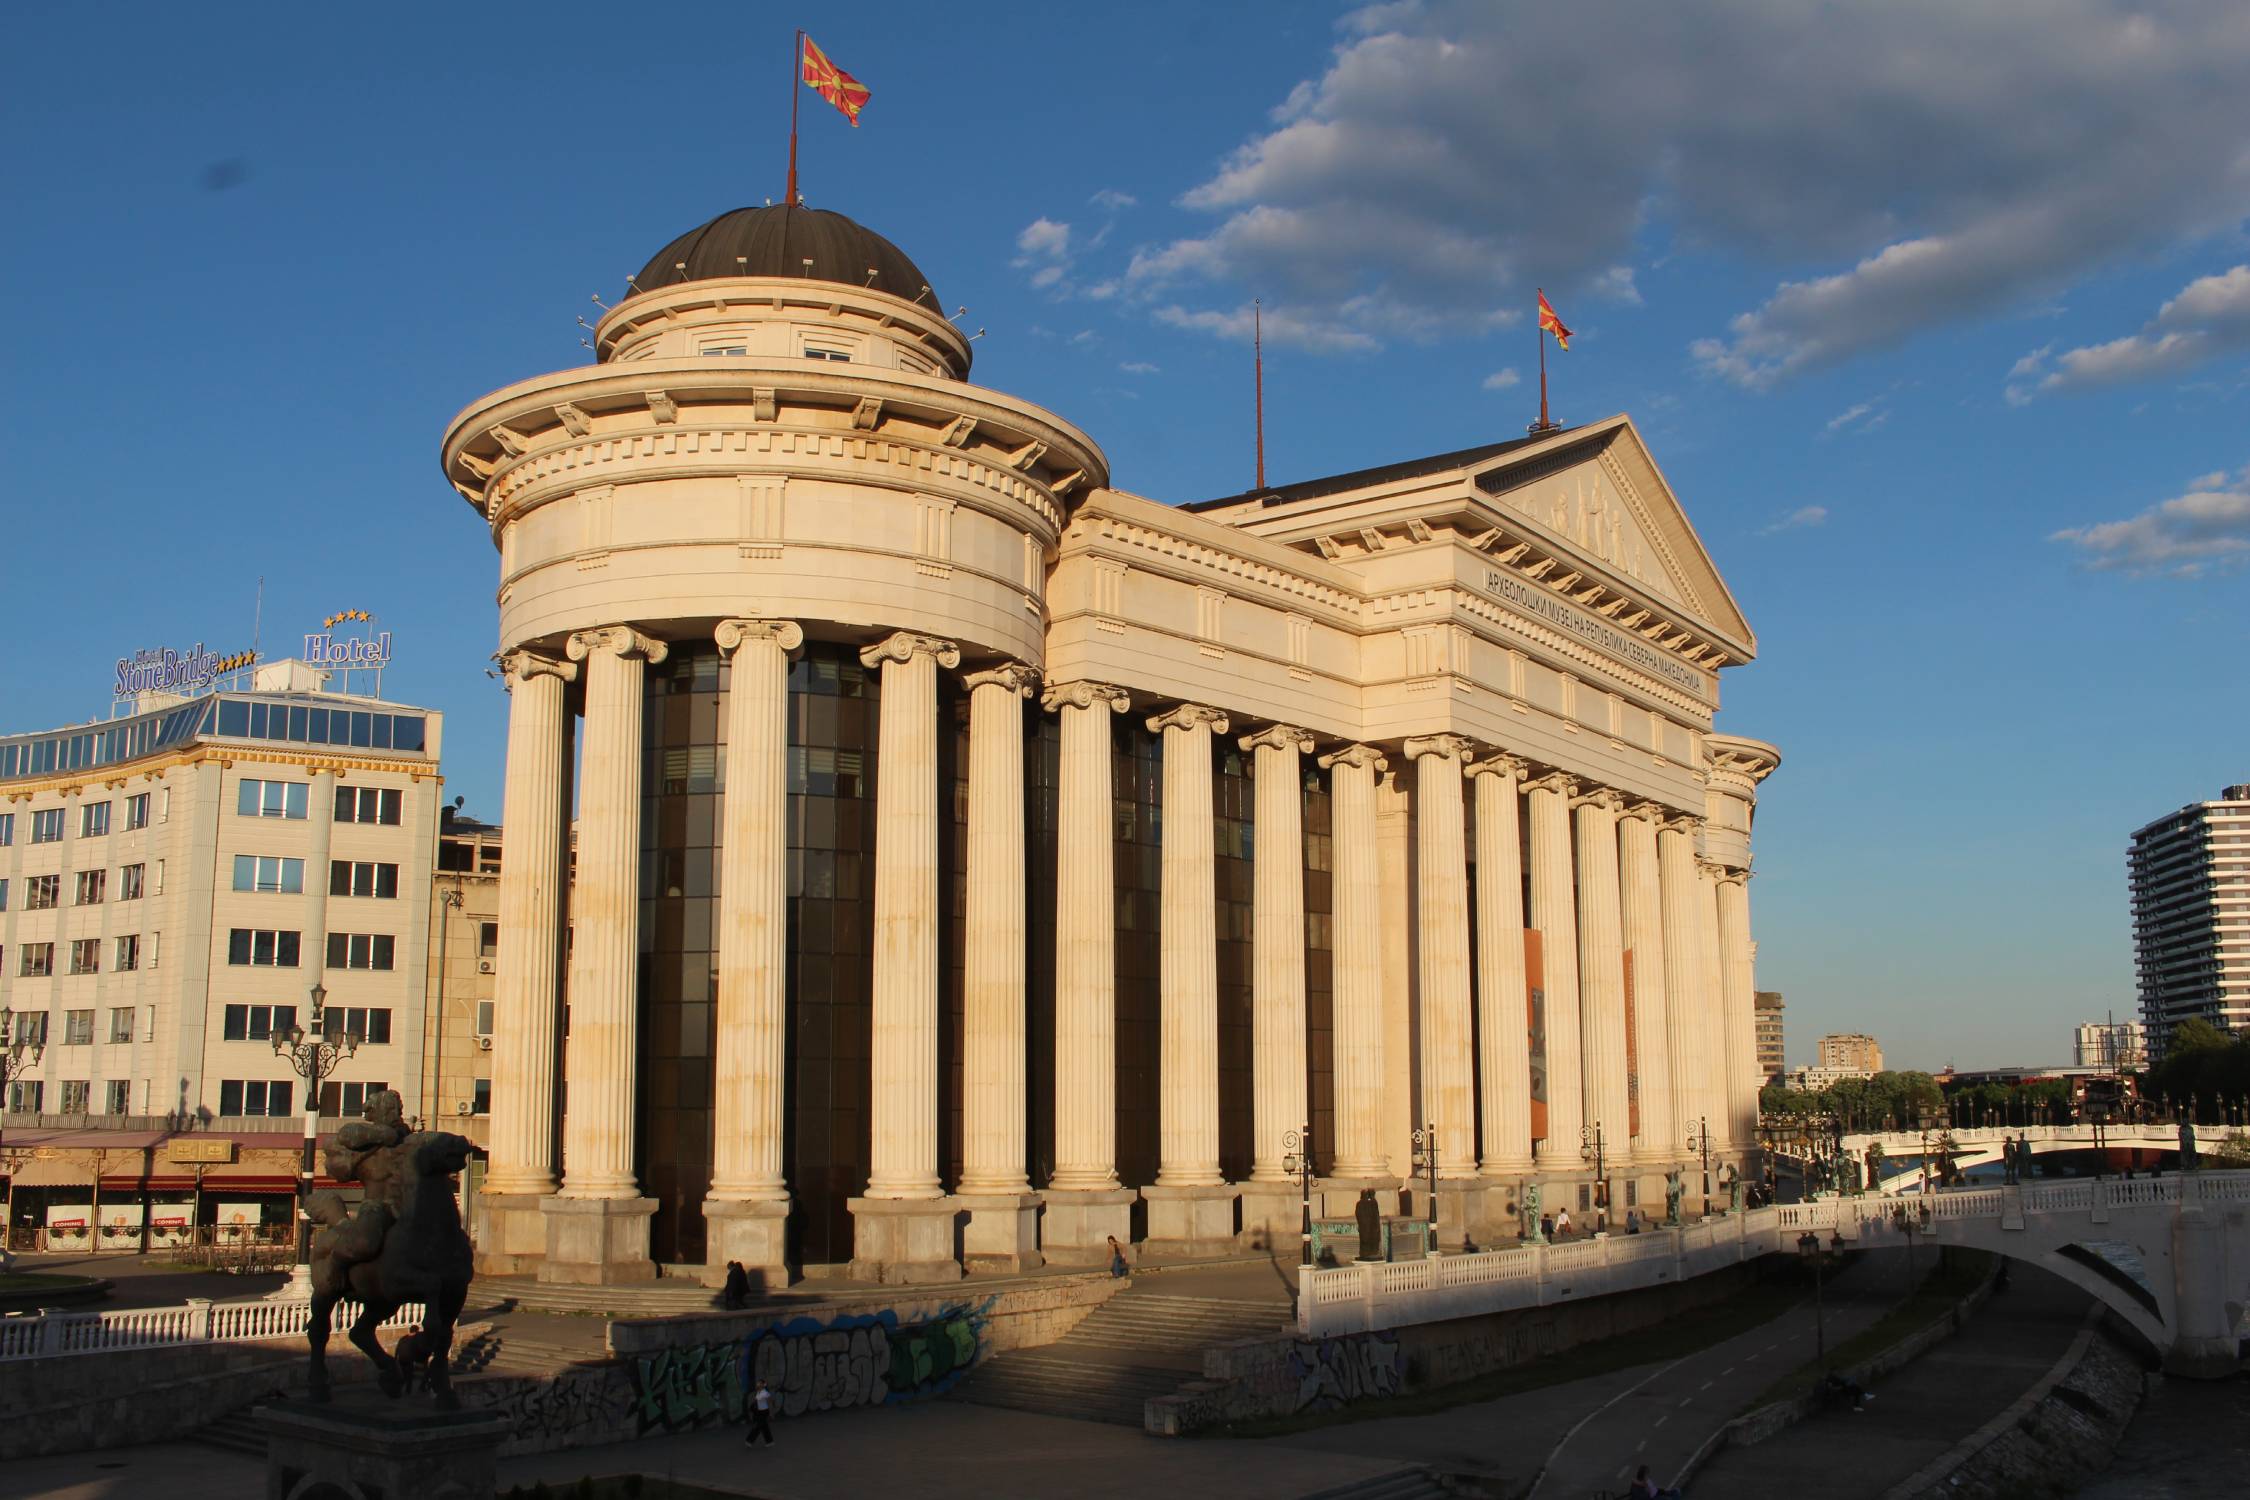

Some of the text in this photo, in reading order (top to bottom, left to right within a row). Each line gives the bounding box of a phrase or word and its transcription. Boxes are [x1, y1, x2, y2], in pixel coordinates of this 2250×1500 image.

[304, 632, 392, 663] Hotel
[1487, 572, 1701, 691] АРХЕОЛОШКИ МУЗЕЈ НА РЕПУБЛИКА СЕВЕРНА МАКЕДОНИЈА
